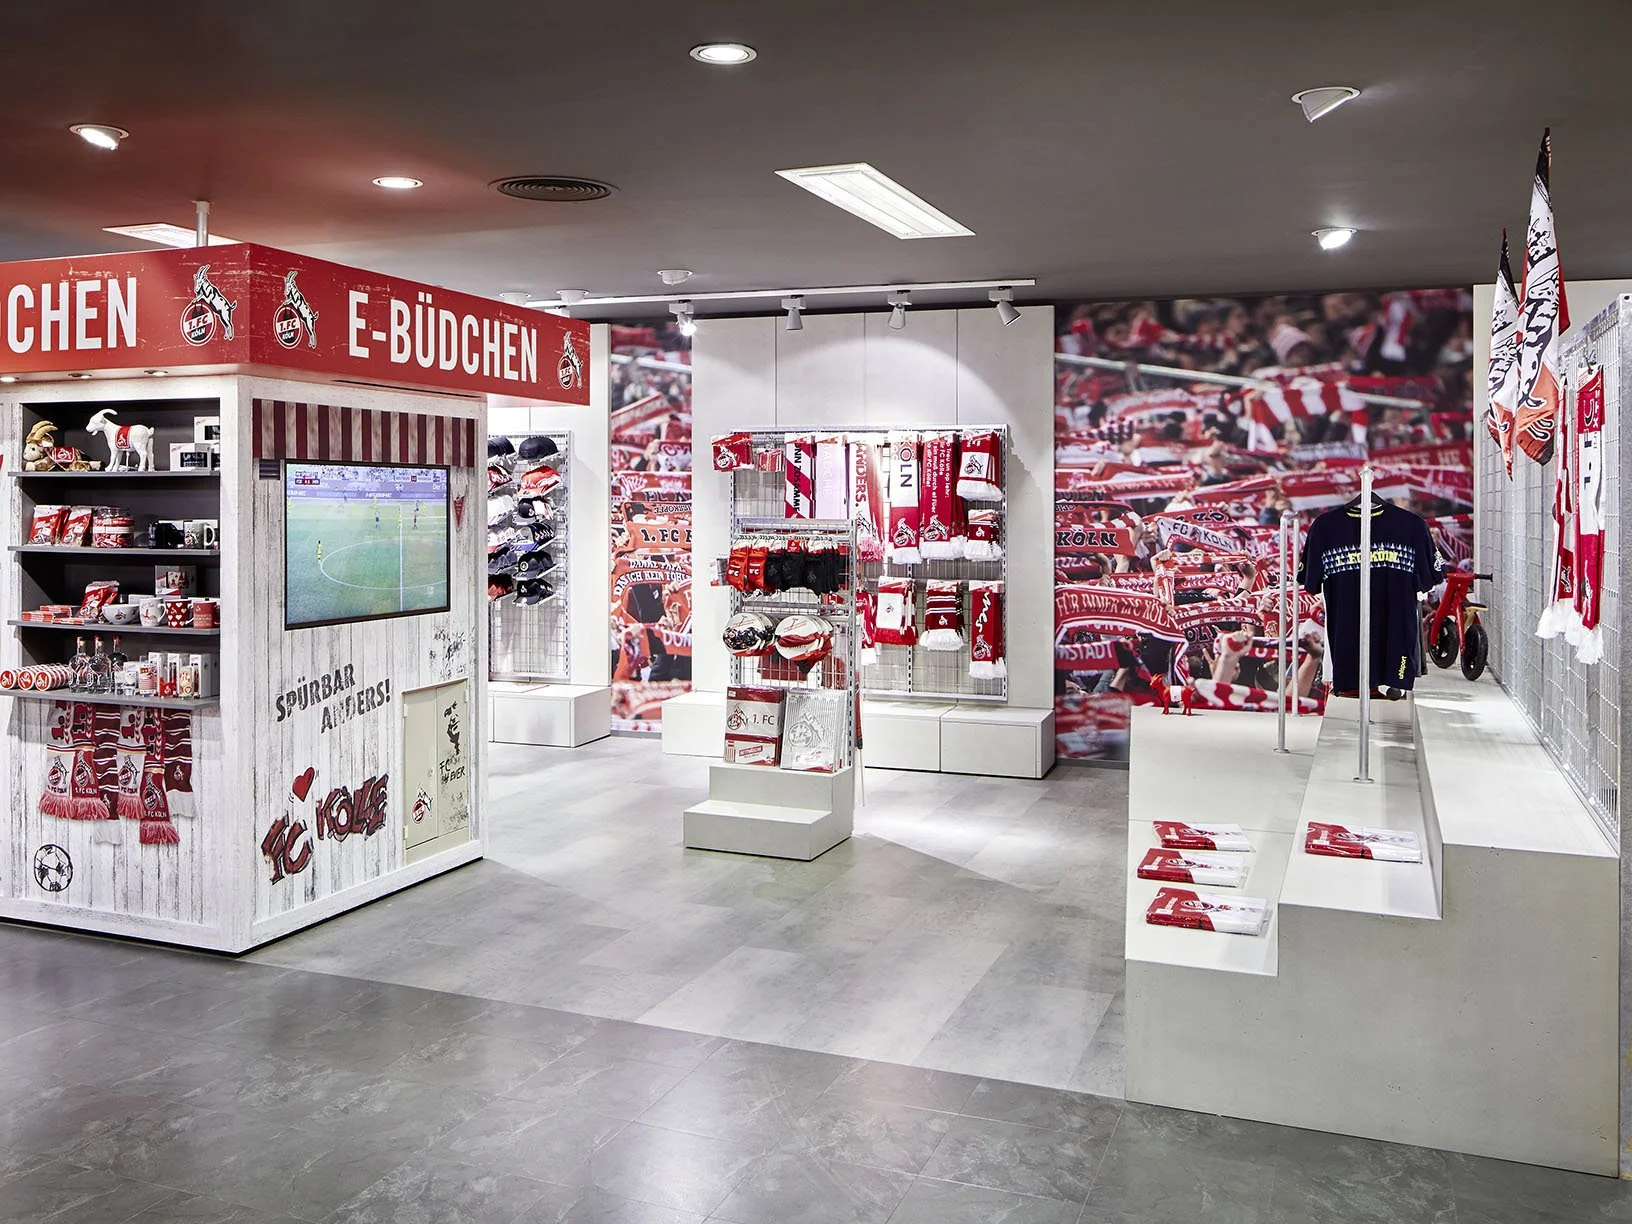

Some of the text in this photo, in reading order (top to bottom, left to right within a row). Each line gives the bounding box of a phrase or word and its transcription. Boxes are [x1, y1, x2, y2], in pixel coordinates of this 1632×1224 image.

[0, 277, 136, 354] CHEN
[349, 290, 537, 384] E-BÜDCHEN
[659, 529, 679, 542] FC
[1056, 528, 1118, 547] KÖLN
[1056, 592, 1079, 616] FÜR
[1142, 600, 1178, 629] KÖLN
[276, 664, 356, 722] SPÜRBAR
[321, 678, 390, 734] ANDERS!
[762, 715, 775, 725] FC
[260, 810, 315, 885] FC
